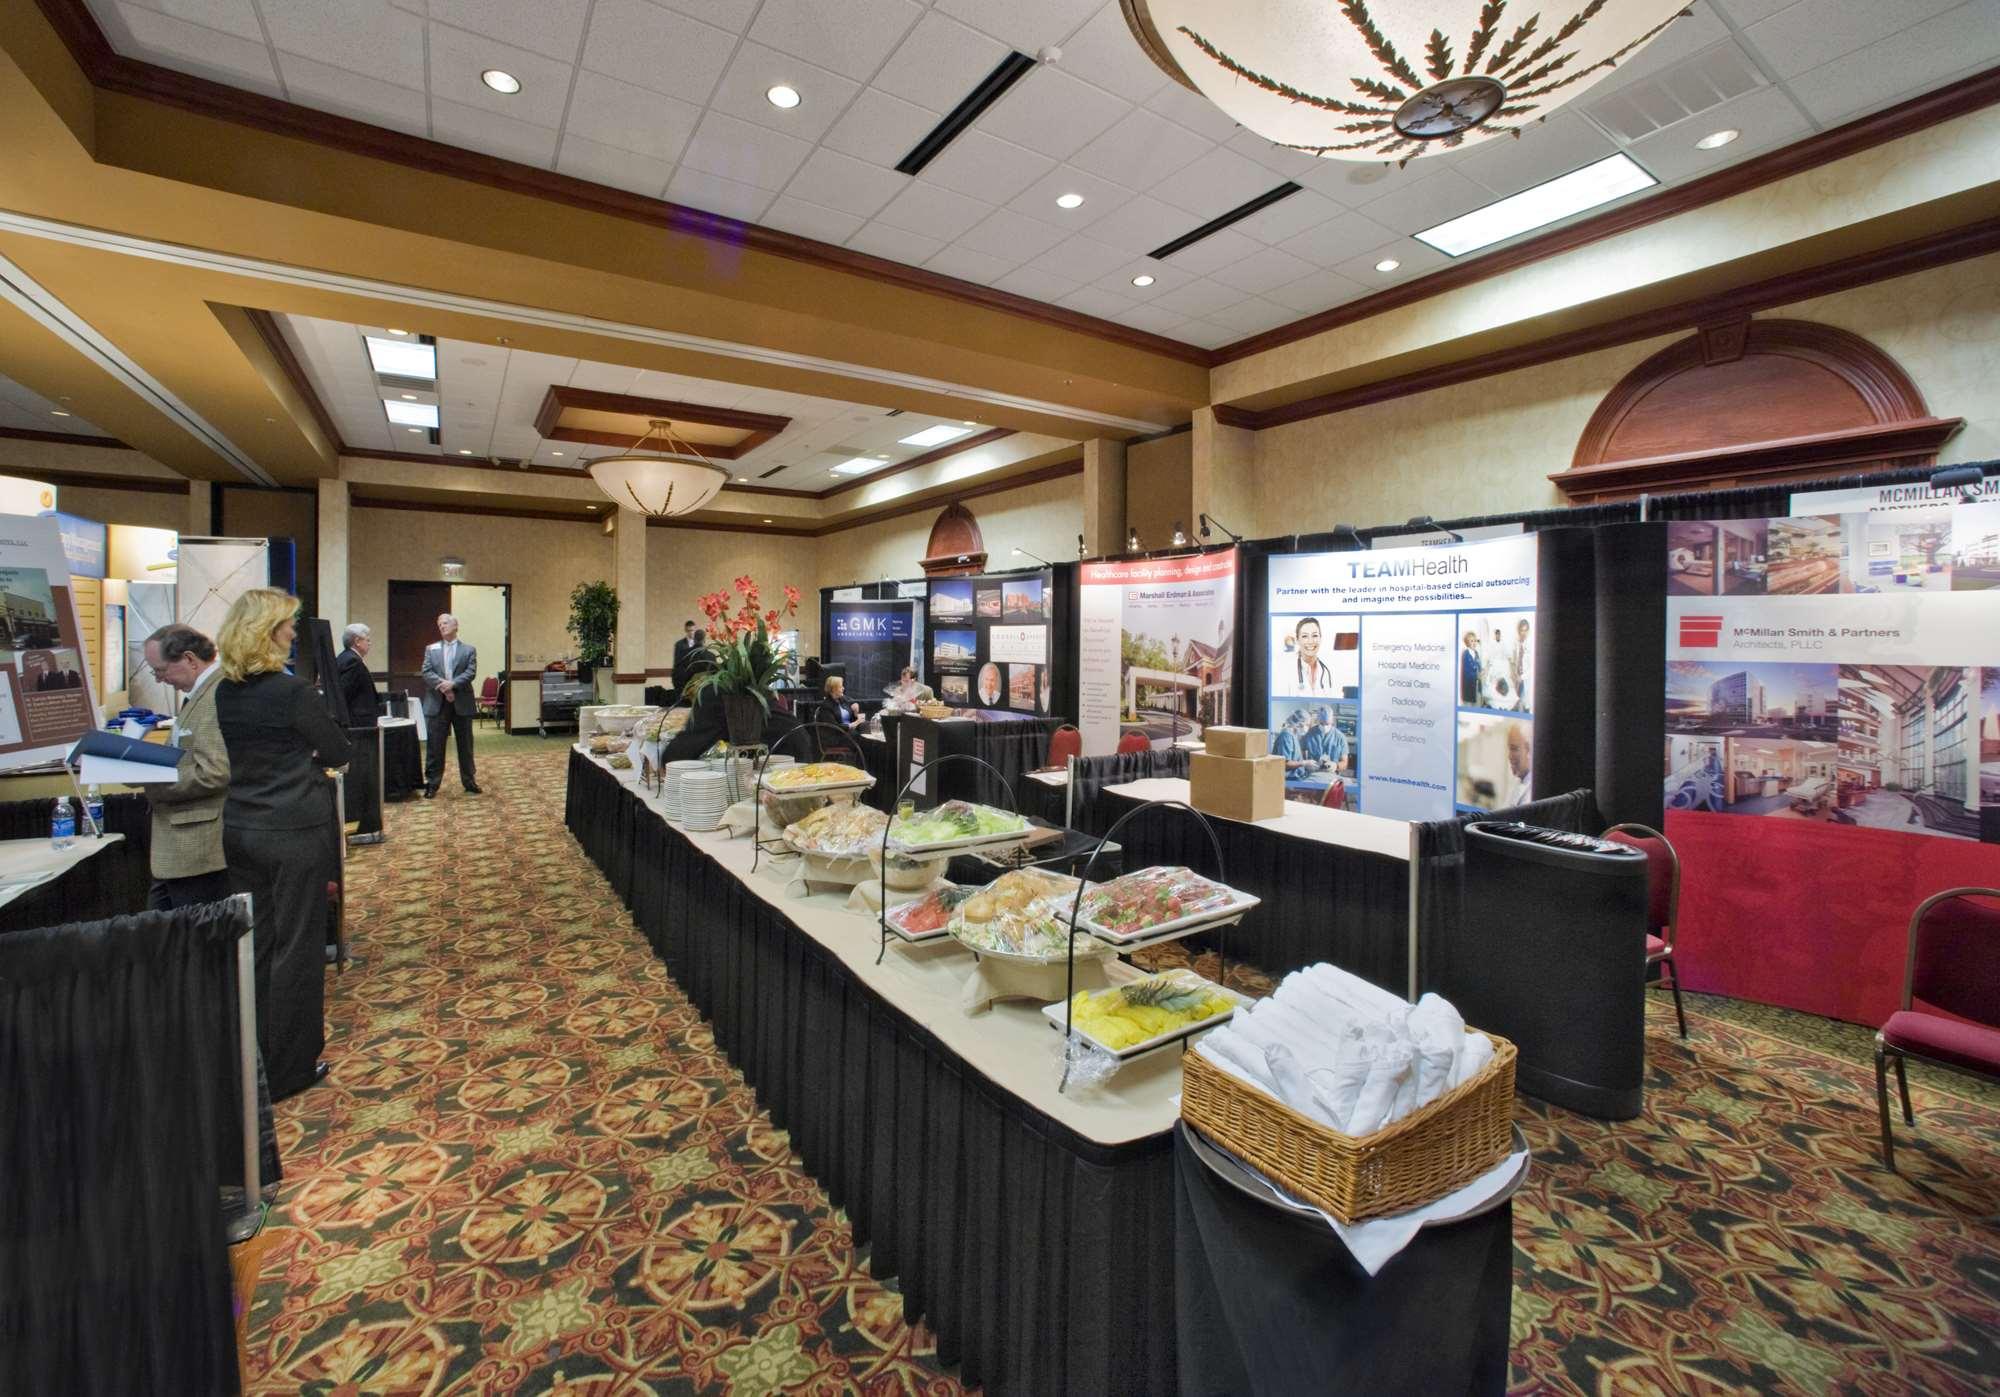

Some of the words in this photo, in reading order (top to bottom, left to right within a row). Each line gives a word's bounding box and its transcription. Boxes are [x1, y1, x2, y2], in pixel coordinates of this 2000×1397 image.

[1347, 554, 1468, 579] TEAMHealth
[1276, 587, 1308, 595] Partner
[1332, 586, 1346, 594] the
[1389, 582, 1452, 592] hospital-based
[1454, 579, 1484, 589] clinical
[1486, 576, 1531, 588] outsourcing
[1139, 591, 1165, 600] Marshall
[1360, 595, 1395, 604] imagine
[1398, 594, 1412, 602] the
[850, 616, 887, 631] GMK
[1787, 628, 1825, 638] Smith
[1827, 628, 1838, 638] &
[1840, 628, 1900, 638] Partners
[1372, 642, 1412, 653] Emergency
[1414, 642, 1446, 652] Medicine
[1733, 640, 1787, 650] Architects,
[1790, 640, 1823, 650] PLLC
[1377, 660, 1407, 670] Hospital
[1408, 661, 1440, 671] Medicine
[1387, 678, 1412, 688] Critical
[1413, 679, 1431, 689] Care
[1391, 696, 1427, 709] Radiology
[1391, 732, 1427, 745] Pediatrics
[1368, 774, 1448, 791] www.teamhealth.com
